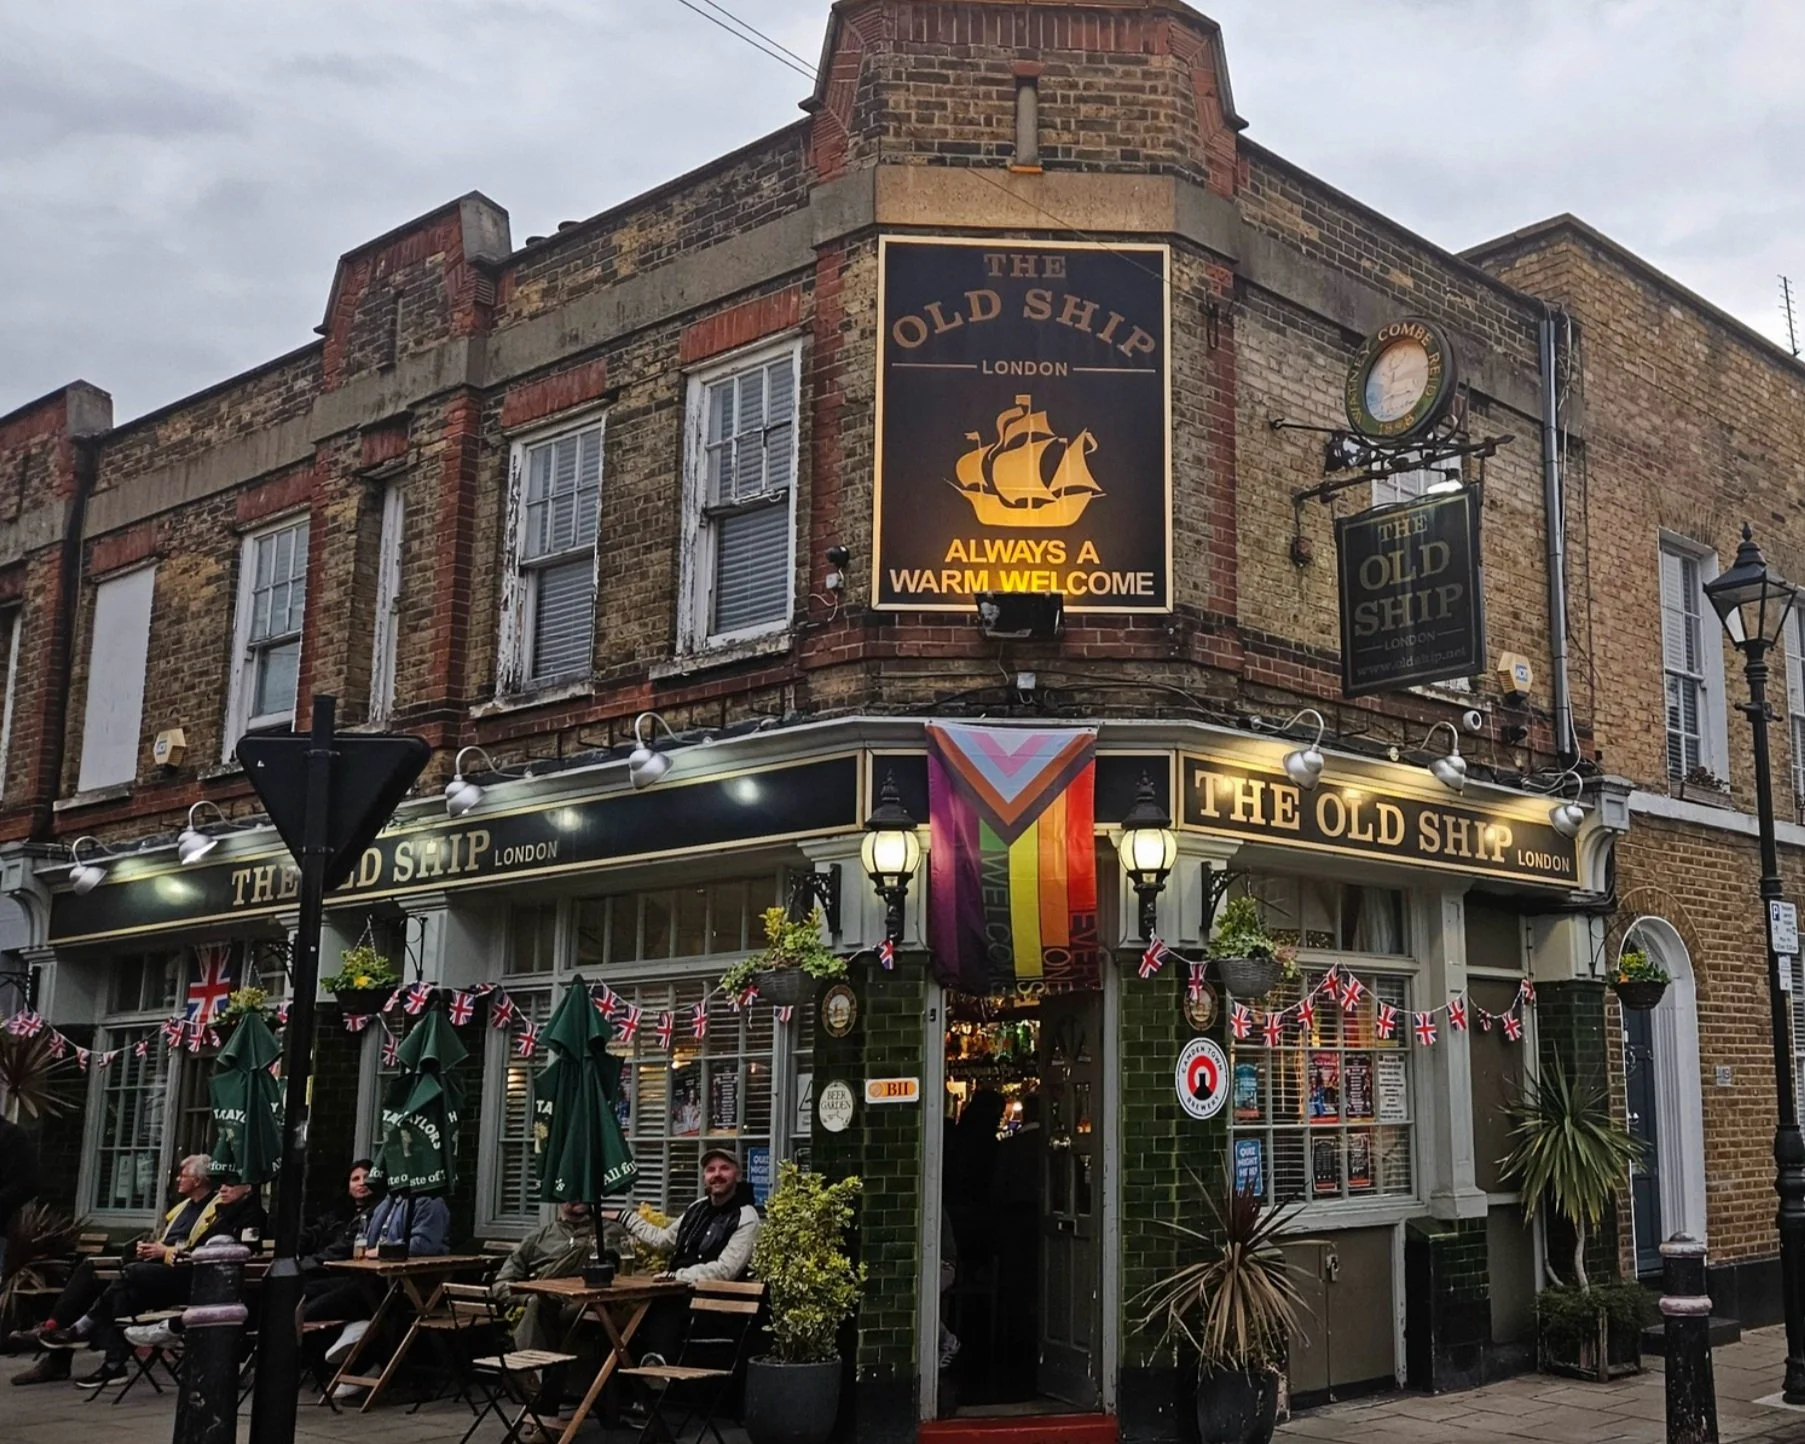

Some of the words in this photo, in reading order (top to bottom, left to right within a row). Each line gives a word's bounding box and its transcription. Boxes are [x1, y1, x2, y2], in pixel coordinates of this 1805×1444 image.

[984, 253, 1066, 279] THE
[892, 288, 1002, 349] OLD
[1023, 287, 1156, 358] SHIP
[982, 359, 1068, 377] LONDON
[1378, 323, 1432, 346] COMBE
[1425, 352, 1440, 396] REID
[1378, 514, 1429, 542] THE
[944, 538, 1067, 565] ALWAYS
[1076, 540, 1101, 565] A
[1359, 540, 1451, 590] OLD
[889, 568, 990, 595] WARM
[999, 569, 1155, 596] WELCOME
[1354, 583, 1464, 637] SHIP
[1384, 631, 1436, 651] LONDON
[1195, 769, 1300, 831] THE
[1316, 792, 1406, 847] OLD
[1418, 810, 1514, 864] SHIP
[1517, 849, 1571, 873] LONDON
[393, 829, 491, 882] SHIP
[494, 840, 559, 867] LONDON
[232, 864, 299, 906] THE
[1182, 1046, 1205, 1074] CAMDEN
[1207, 1047, 1223, 1071] TOWN
[820, 1100, 851, 1110] GARDEN
[827, 1090, 846, 1100] BEER
[1187, 1095, 1219, 1111] BREWERY
[602, 1166, 622, 1186] All
